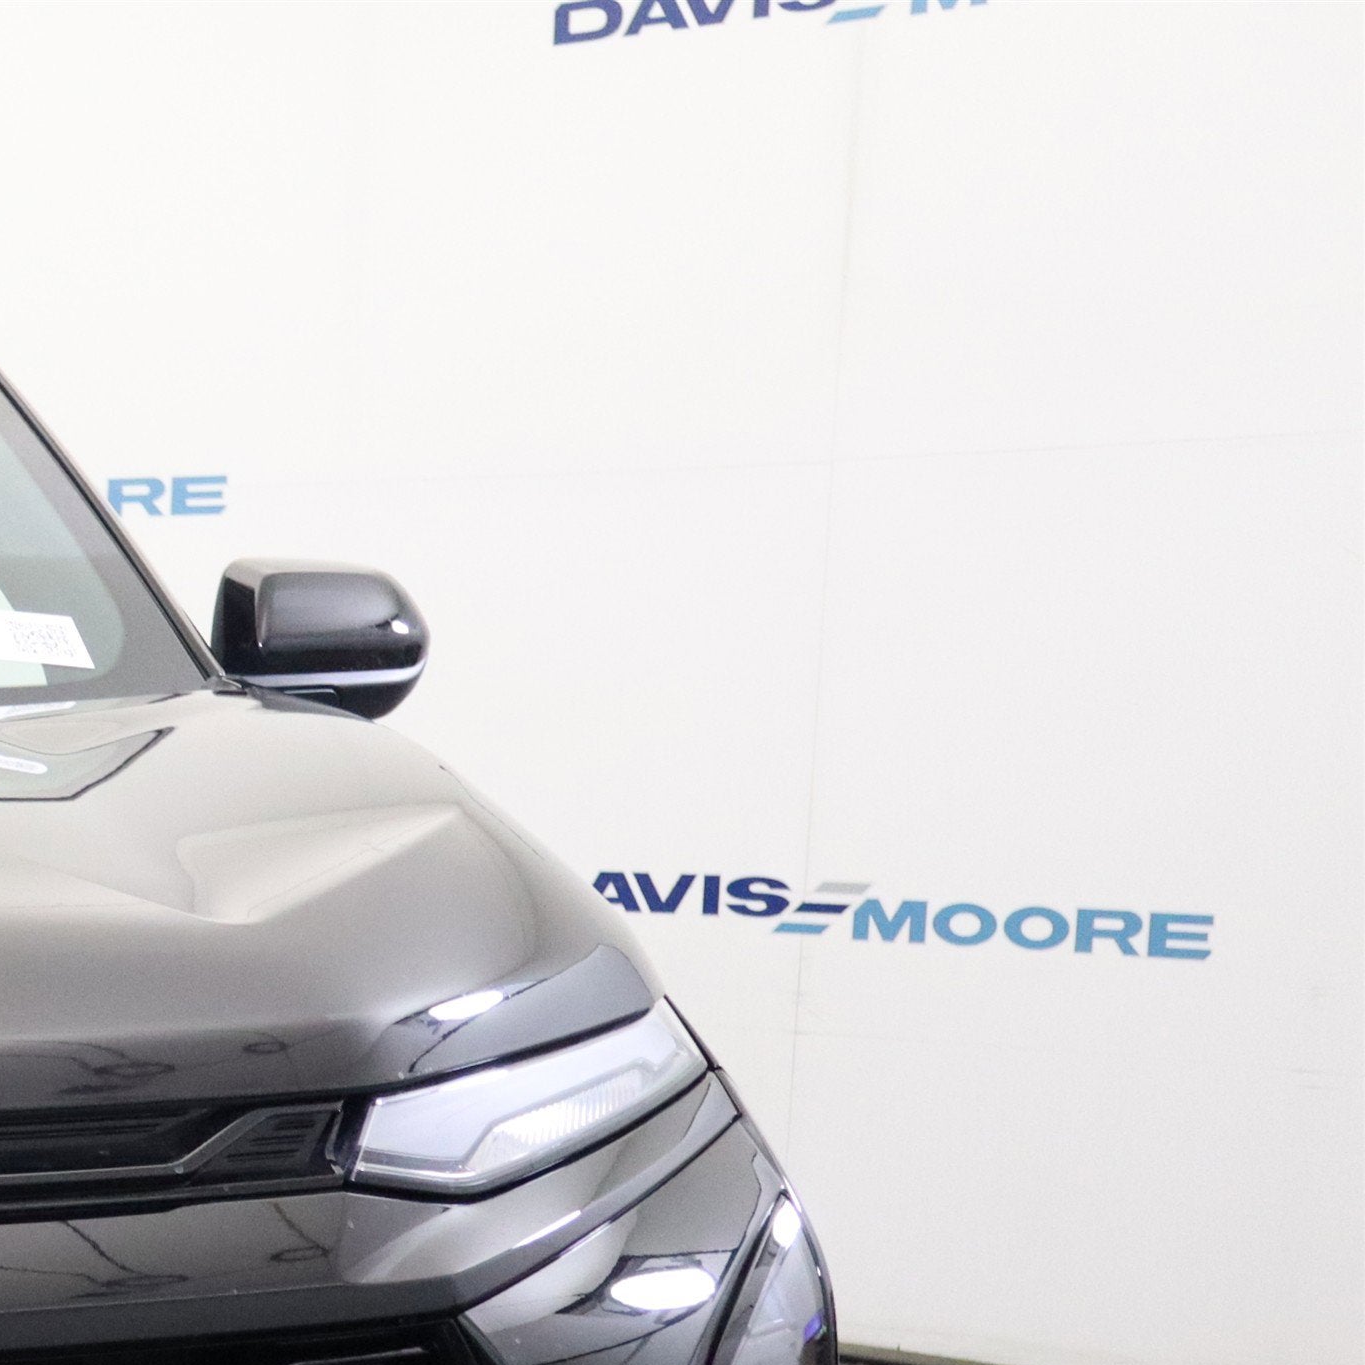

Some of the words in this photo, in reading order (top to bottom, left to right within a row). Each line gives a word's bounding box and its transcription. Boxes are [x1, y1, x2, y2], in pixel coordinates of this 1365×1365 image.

[553, 0, 837, 45] DAV
[592, 870, 790, 918] AVIS
[852, 897, 1215, 960] MOORE
